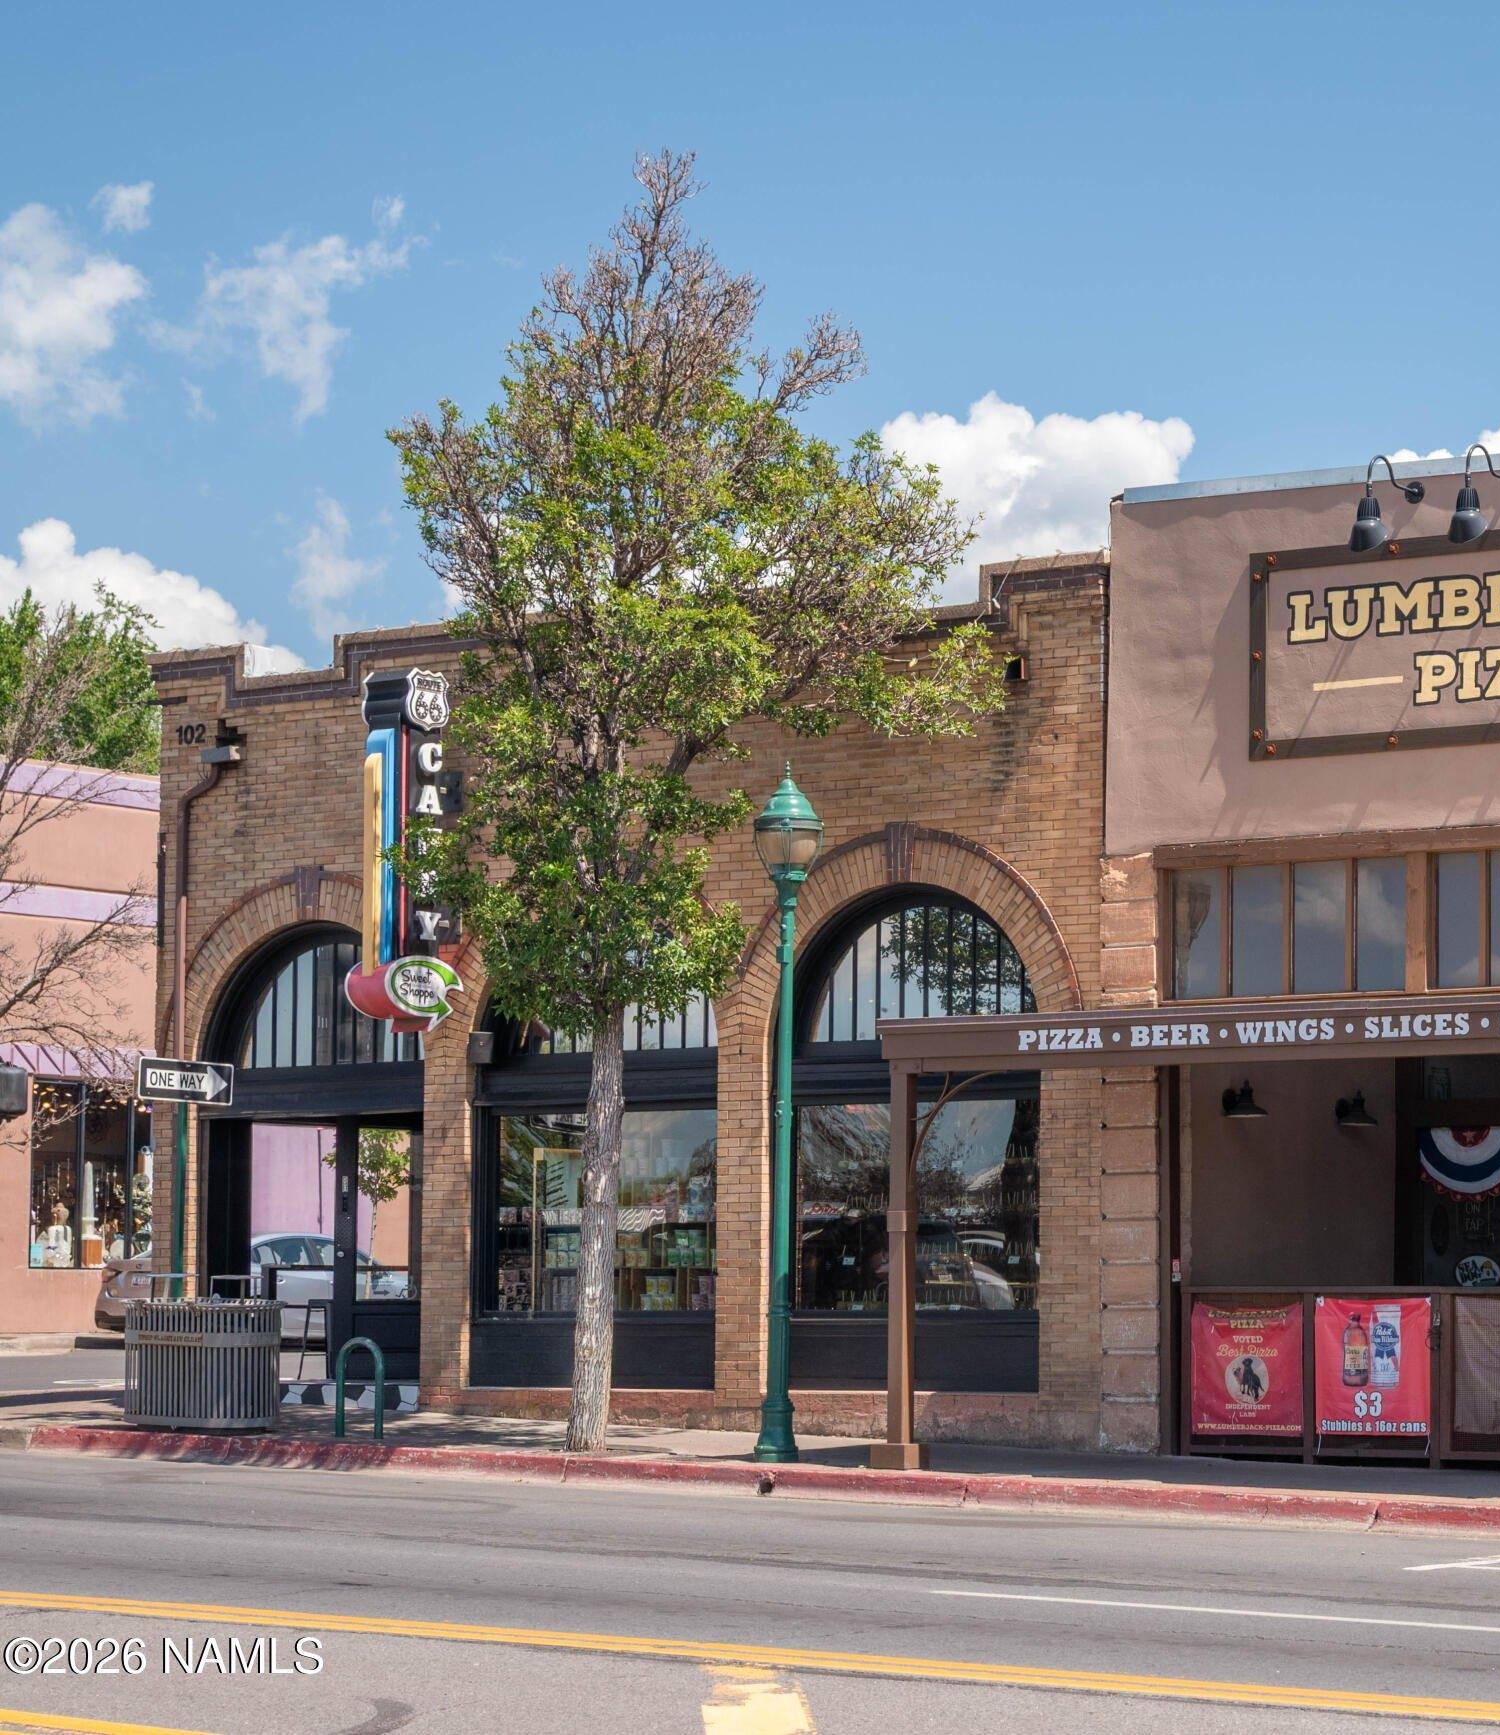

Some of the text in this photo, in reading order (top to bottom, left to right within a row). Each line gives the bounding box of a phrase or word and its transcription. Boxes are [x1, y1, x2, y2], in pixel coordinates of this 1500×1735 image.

[416, 677, 444, 693] ROUTE
[415, 691, 442, 723] 66
[176, 723, 206, 746] 102
[415, 742, 443, 941] CAY
[401, 968, 433, 985] Sweet
[400, 983, 435, 1005] Shoppe
[1018, 1029, 1104, 1051] PIZZA
[1130, 1024, 1210, 1048] BEER
[1235, 1018, 1336, 1045] WINGS
[1364, 1012, 1470, 1039] SLICES
[149, 1071, 205, 1090] ONE WAY
[1463, 1217, 1485, 1233] TAP
[1230, 1319, 1264, 1329] PIZZA
[1232, 1335, 1264, 1344] VOTED
[1216, 1344, 1279, 1358] Best Pizza
[1225, 1403, 1272, 1411] INDEPENDENT
[1354, 1390, 1383, 1418] $3
[1197, 1422, 1302, 1432] WWW.LUMBERJACK-PIZZA.COM
[1321, 1419, 1427, 1432] Stubbies & 16oz cans
